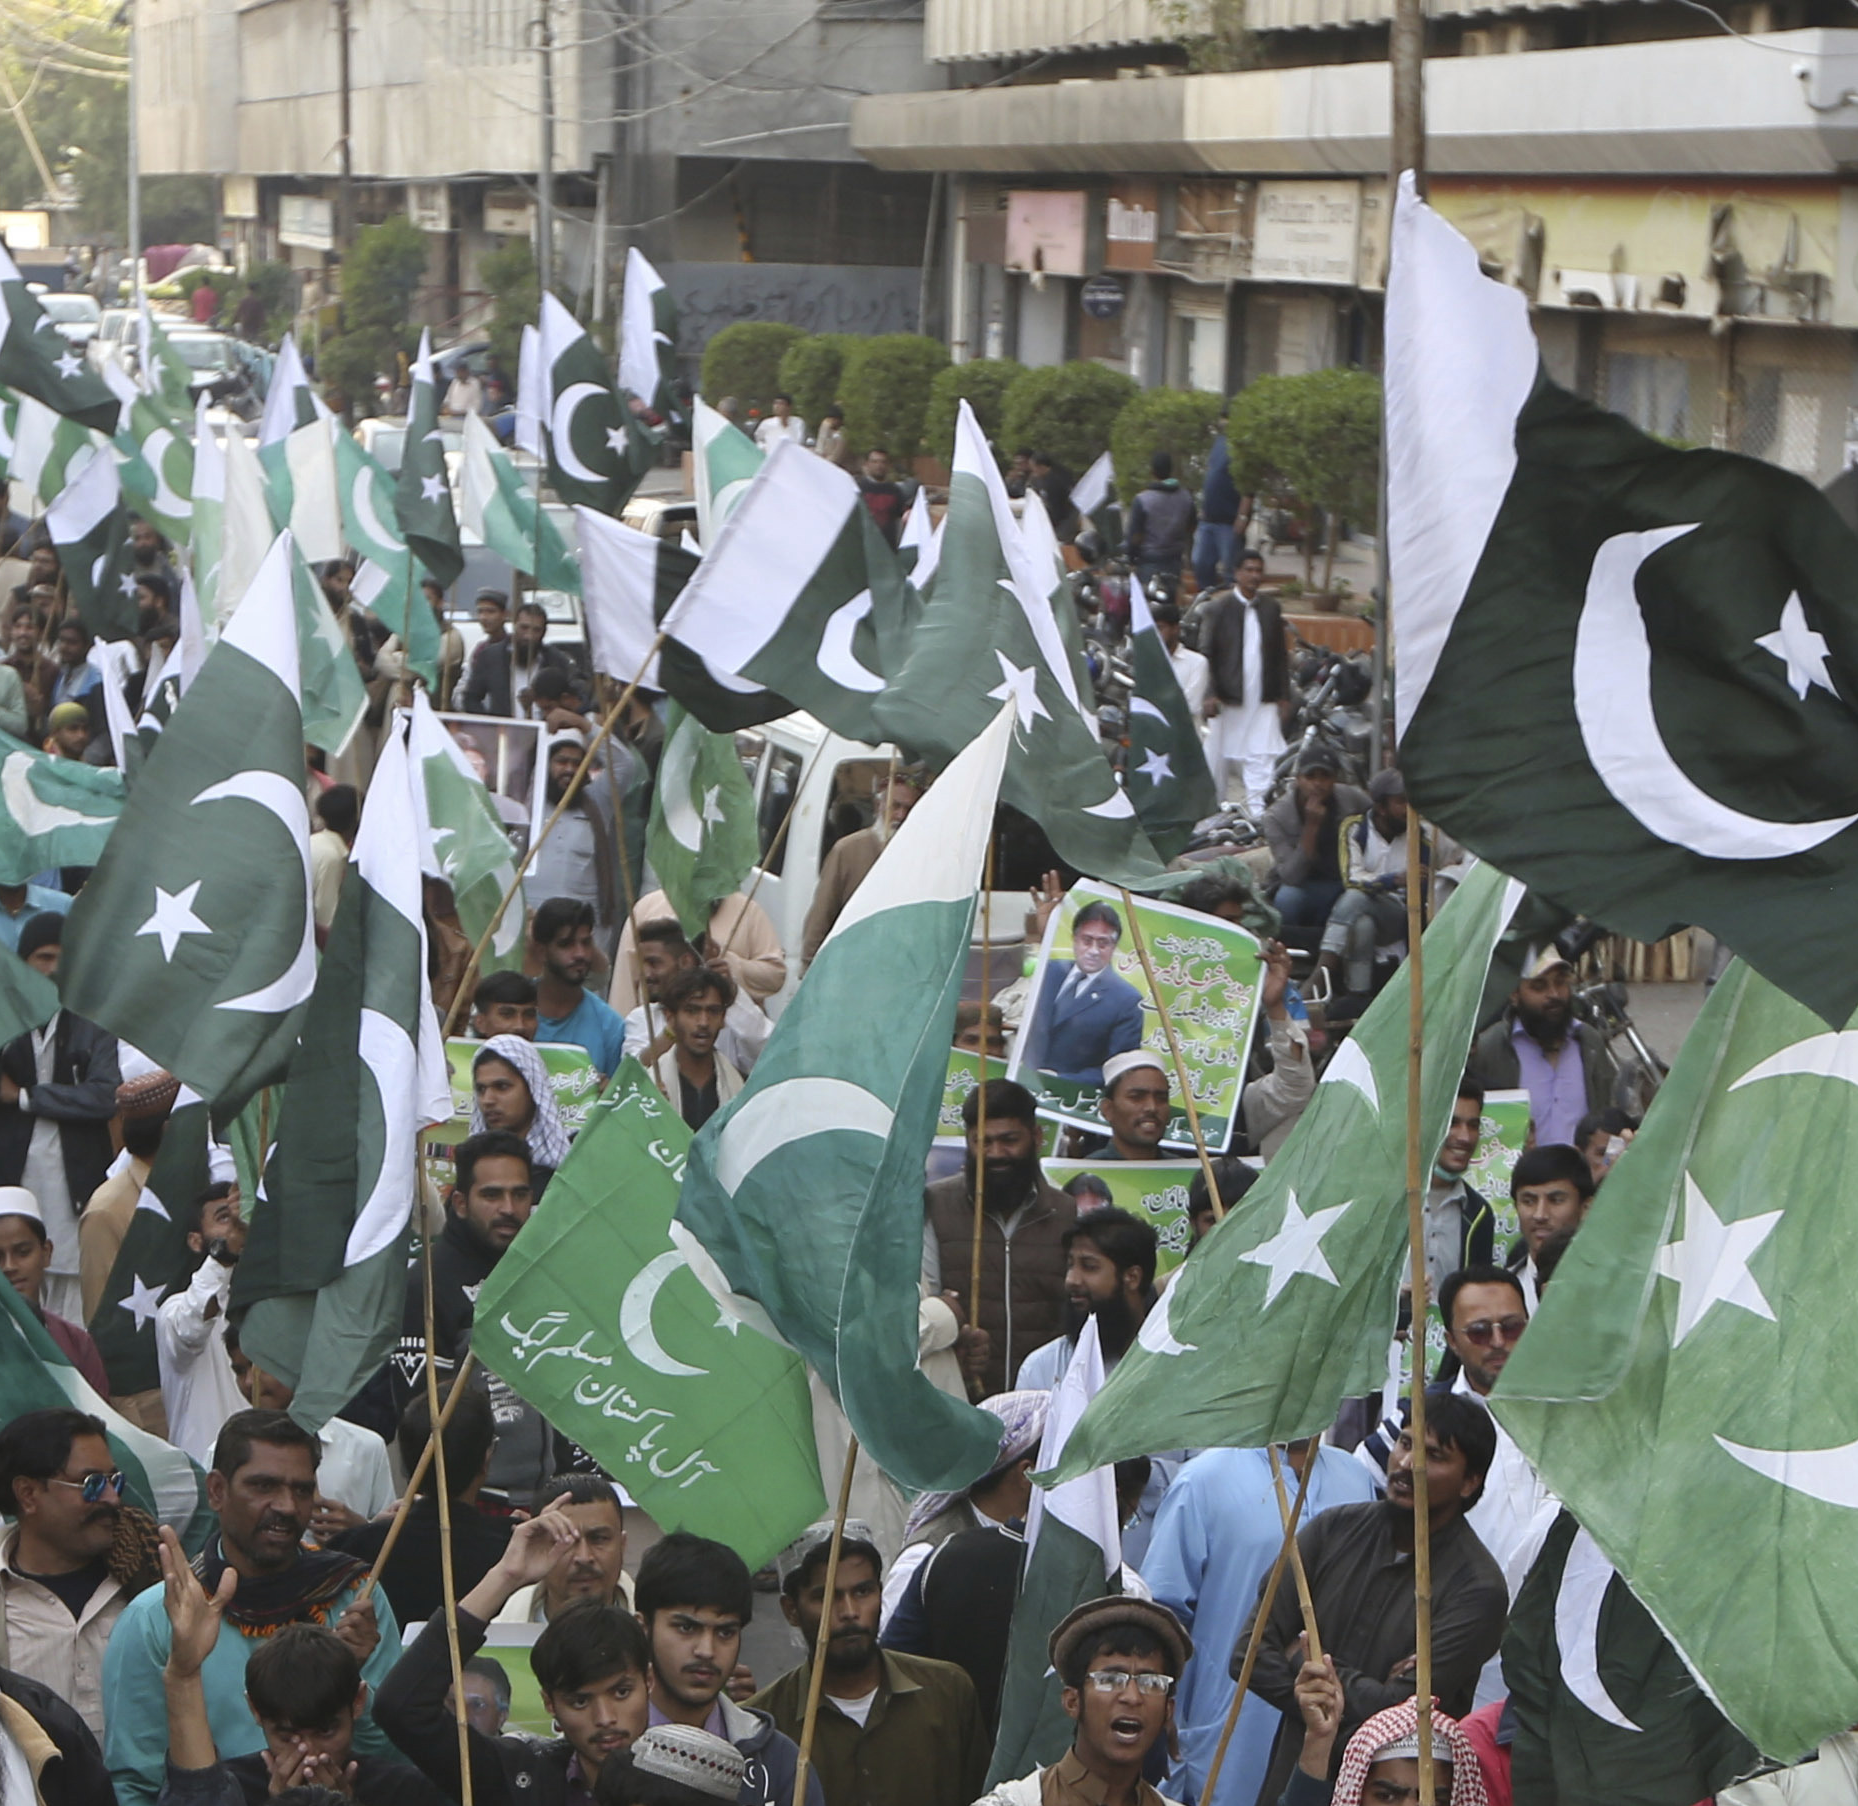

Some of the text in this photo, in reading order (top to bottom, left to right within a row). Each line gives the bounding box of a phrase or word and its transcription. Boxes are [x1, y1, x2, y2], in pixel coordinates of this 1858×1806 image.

[500, 1311, 570, 1360] لیگ
[525, 1330, 612, 1374] مسلم
[573, 1374, 676, 1463] پاکستان
